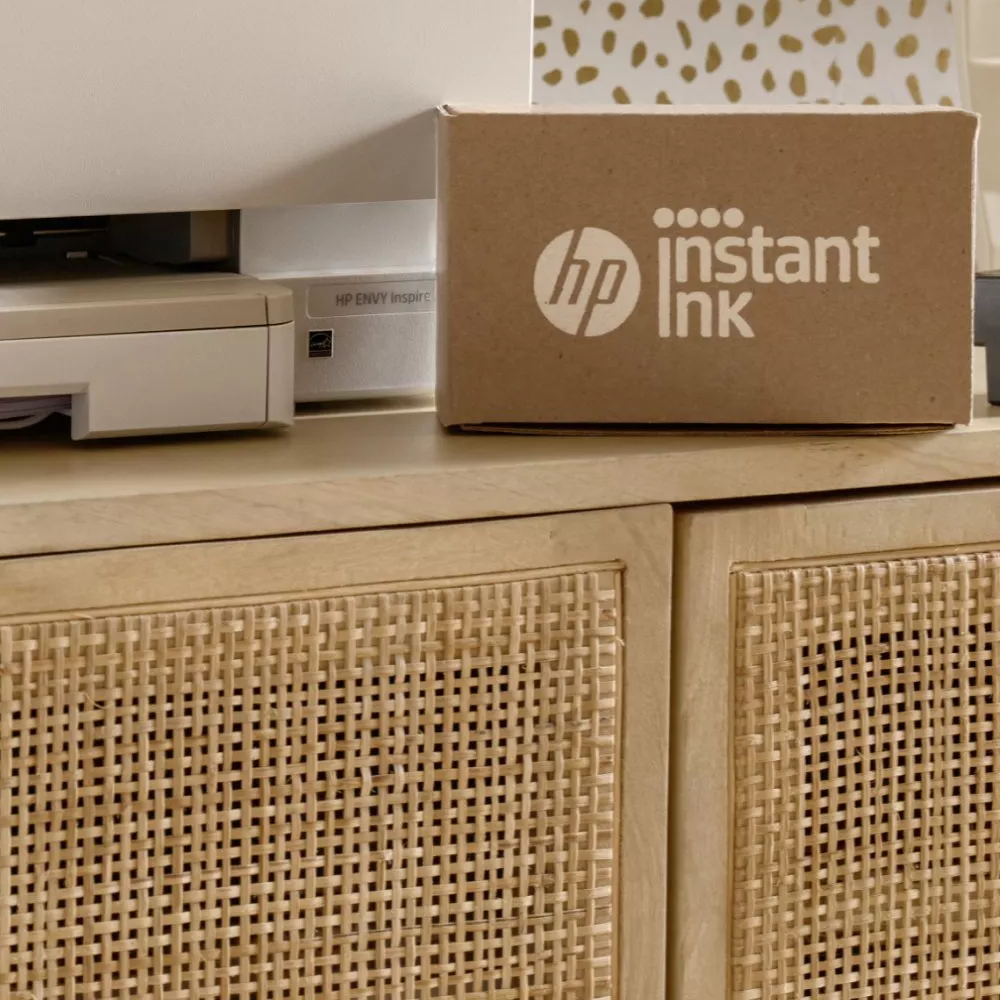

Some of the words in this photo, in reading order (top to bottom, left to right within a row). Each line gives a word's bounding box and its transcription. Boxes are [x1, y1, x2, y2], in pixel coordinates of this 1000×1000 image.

[335, 293, 353, 307] HP
[355, 291, 388, 305] ENVY
[547, 227, 628, 336] hp
